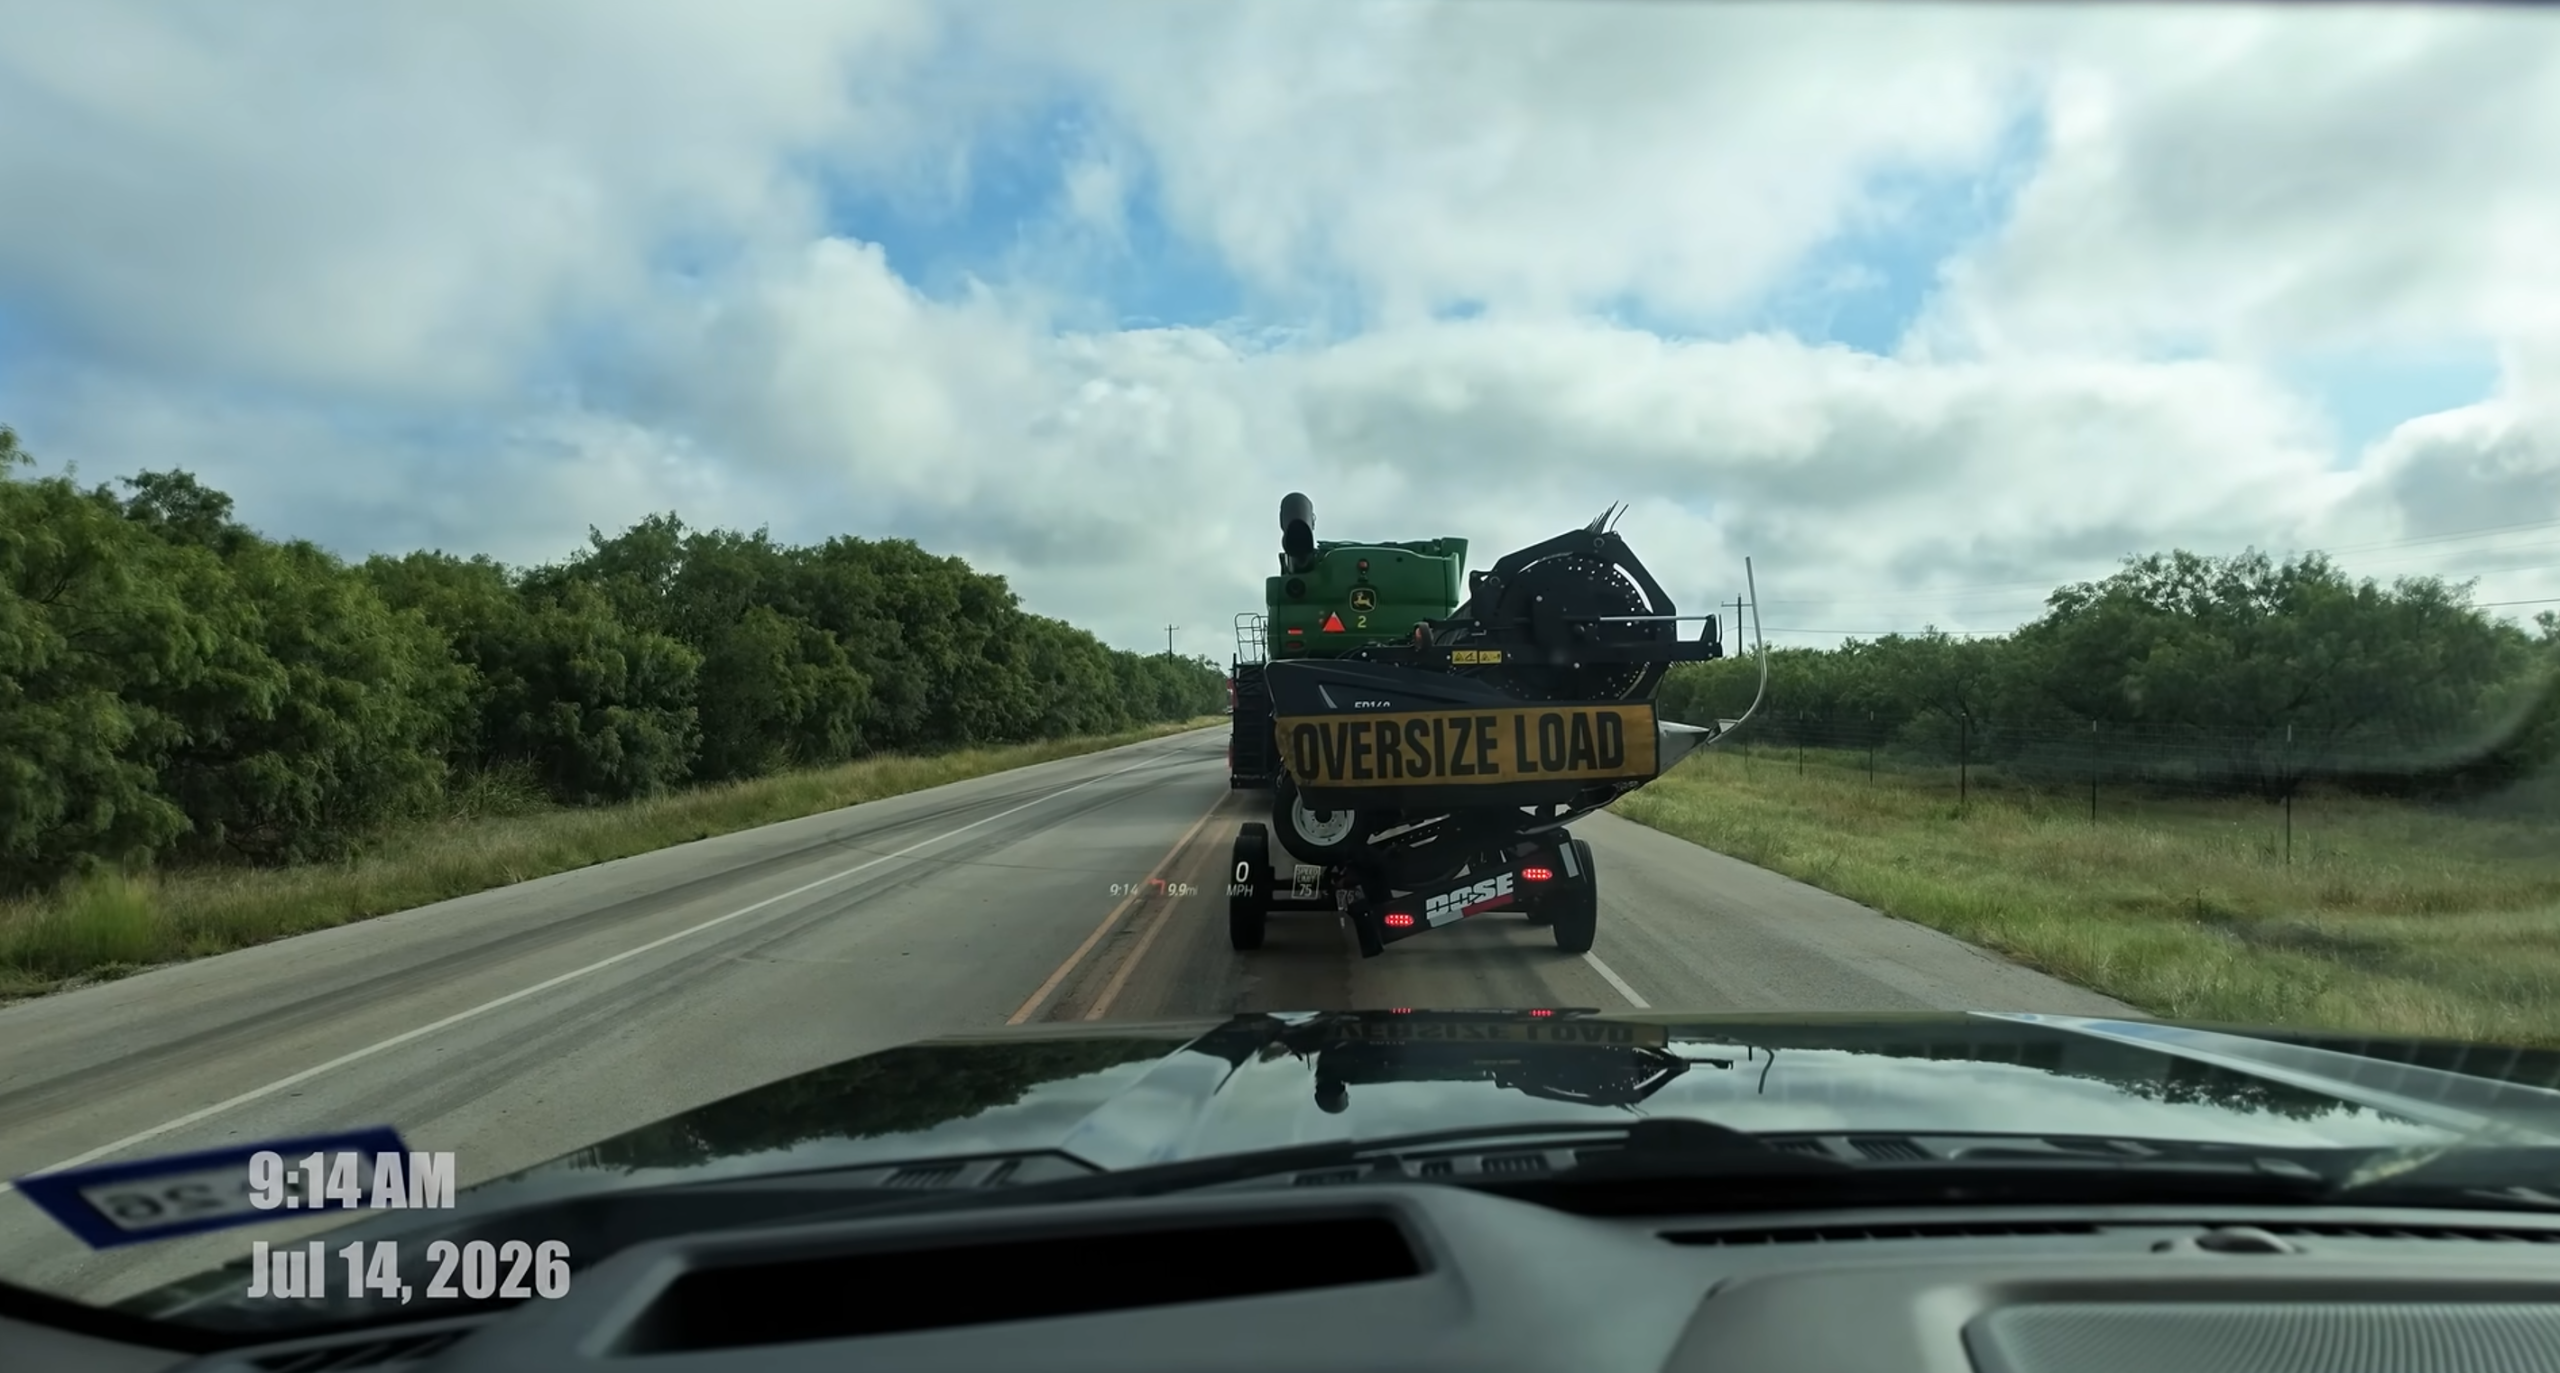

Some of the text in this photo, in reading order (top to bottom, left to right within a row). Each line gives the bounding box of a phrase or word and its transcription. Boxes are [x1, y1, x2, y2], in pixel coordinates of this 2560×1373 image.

[1357, 615, 1367, 628] 2
[1294, 711, 1625, 780] OVERSIZE LOAD
[1235, 861, 1250, 882] 0
[1109, 883, 1139, 896] 9:14
[1226, 884, 1254, 897] MPH
[1299, 884, 1313, 897] 75
